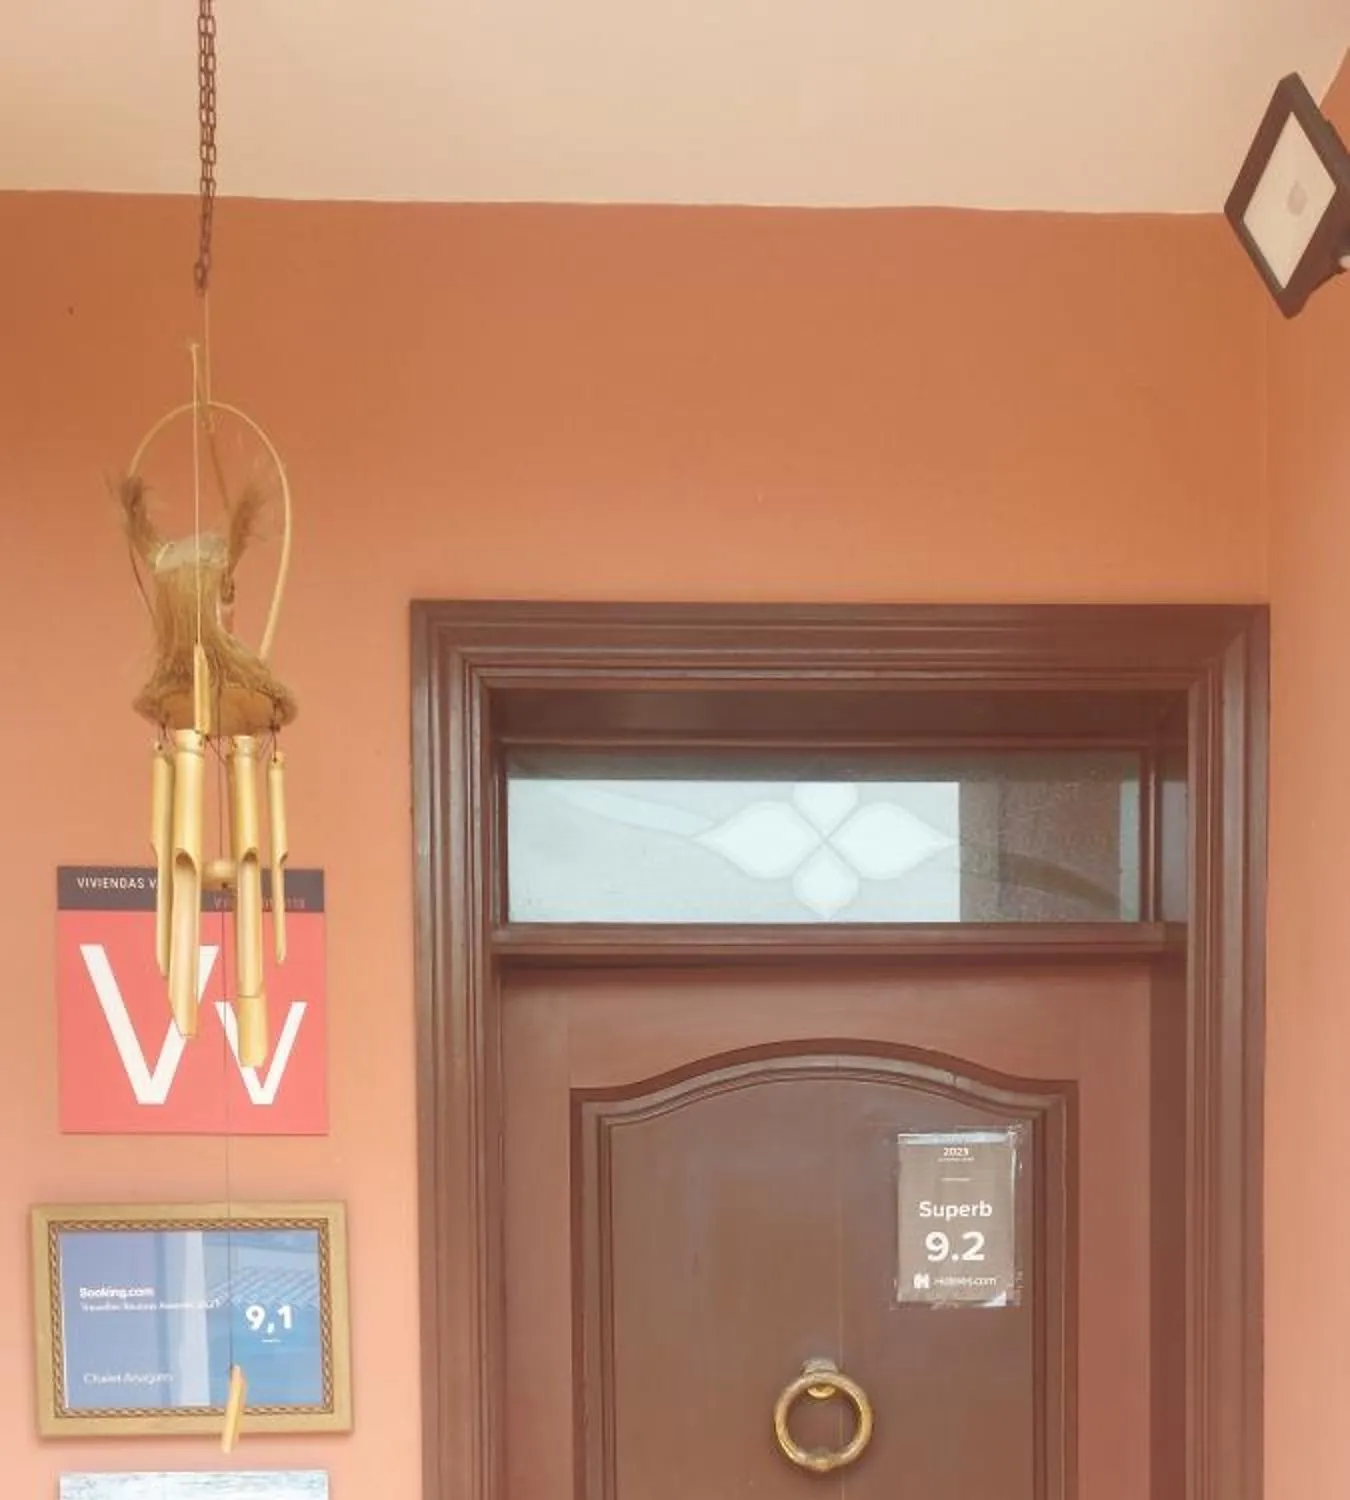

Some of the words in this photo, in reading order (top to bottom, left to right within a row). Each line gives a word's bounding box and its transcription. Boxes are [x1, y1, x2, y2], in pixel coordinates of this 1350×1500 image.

[76, 876, 145, 889] VIVIENDAS
[919, 1200, 993, 1222] Superb
[925, 1231, 985, 1262] 9.2
[79, 1286, 155, 1300] Booking.com
[245, 1304, 294, 1334] 9,1
